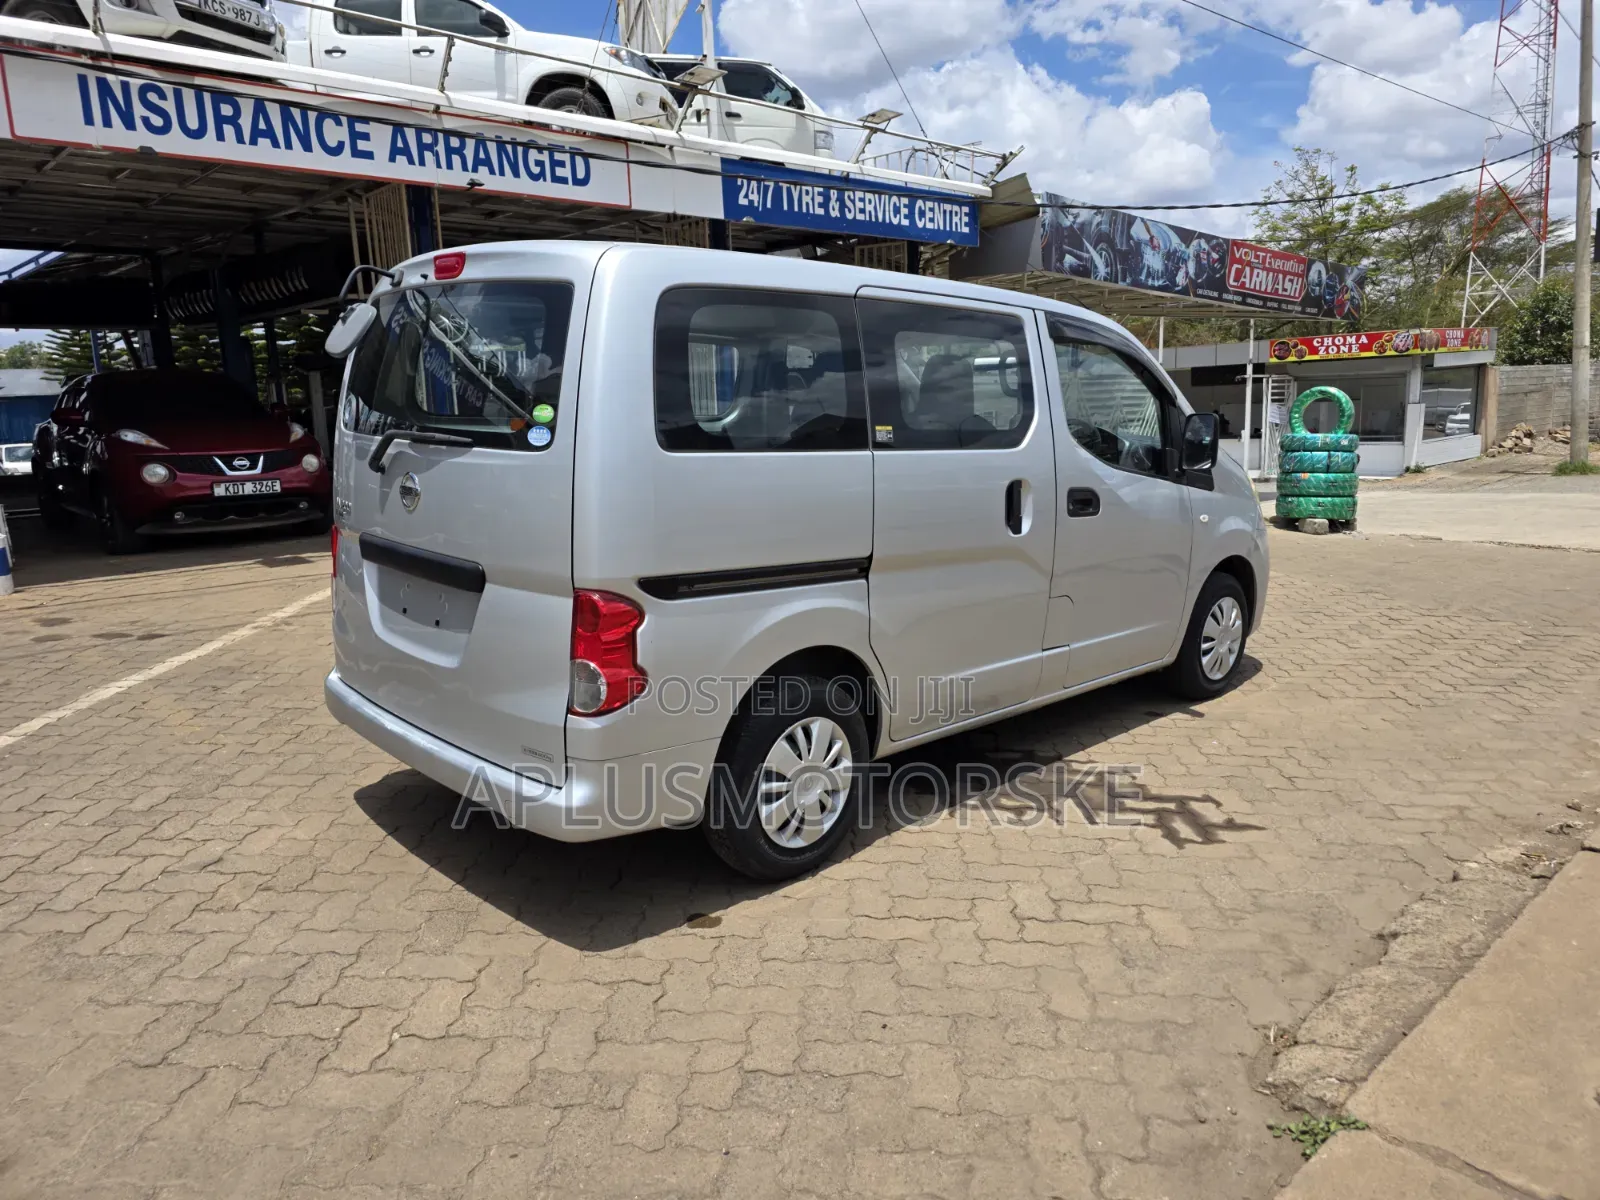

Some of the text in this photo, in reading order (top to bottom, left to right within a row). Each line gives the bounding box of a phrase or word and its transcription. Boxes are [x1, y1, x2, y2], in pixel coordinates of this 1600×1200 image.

[203, 0, 226, 15] KCS
[77, 74, 592, 188] INSURANCE ARRANGED
[737, 178, 970, 233] 24/7 TYRE & SERVICE CENTRE
[1233, 246, 1266, 263] VOLT
[1229, 263, 1302, 297] CARWASH
[1313, 335, 1368, 346] CHOMA
[1318, 344, 1360, 355] ZONE
[224, 481, 278, 495] KDT 326E
